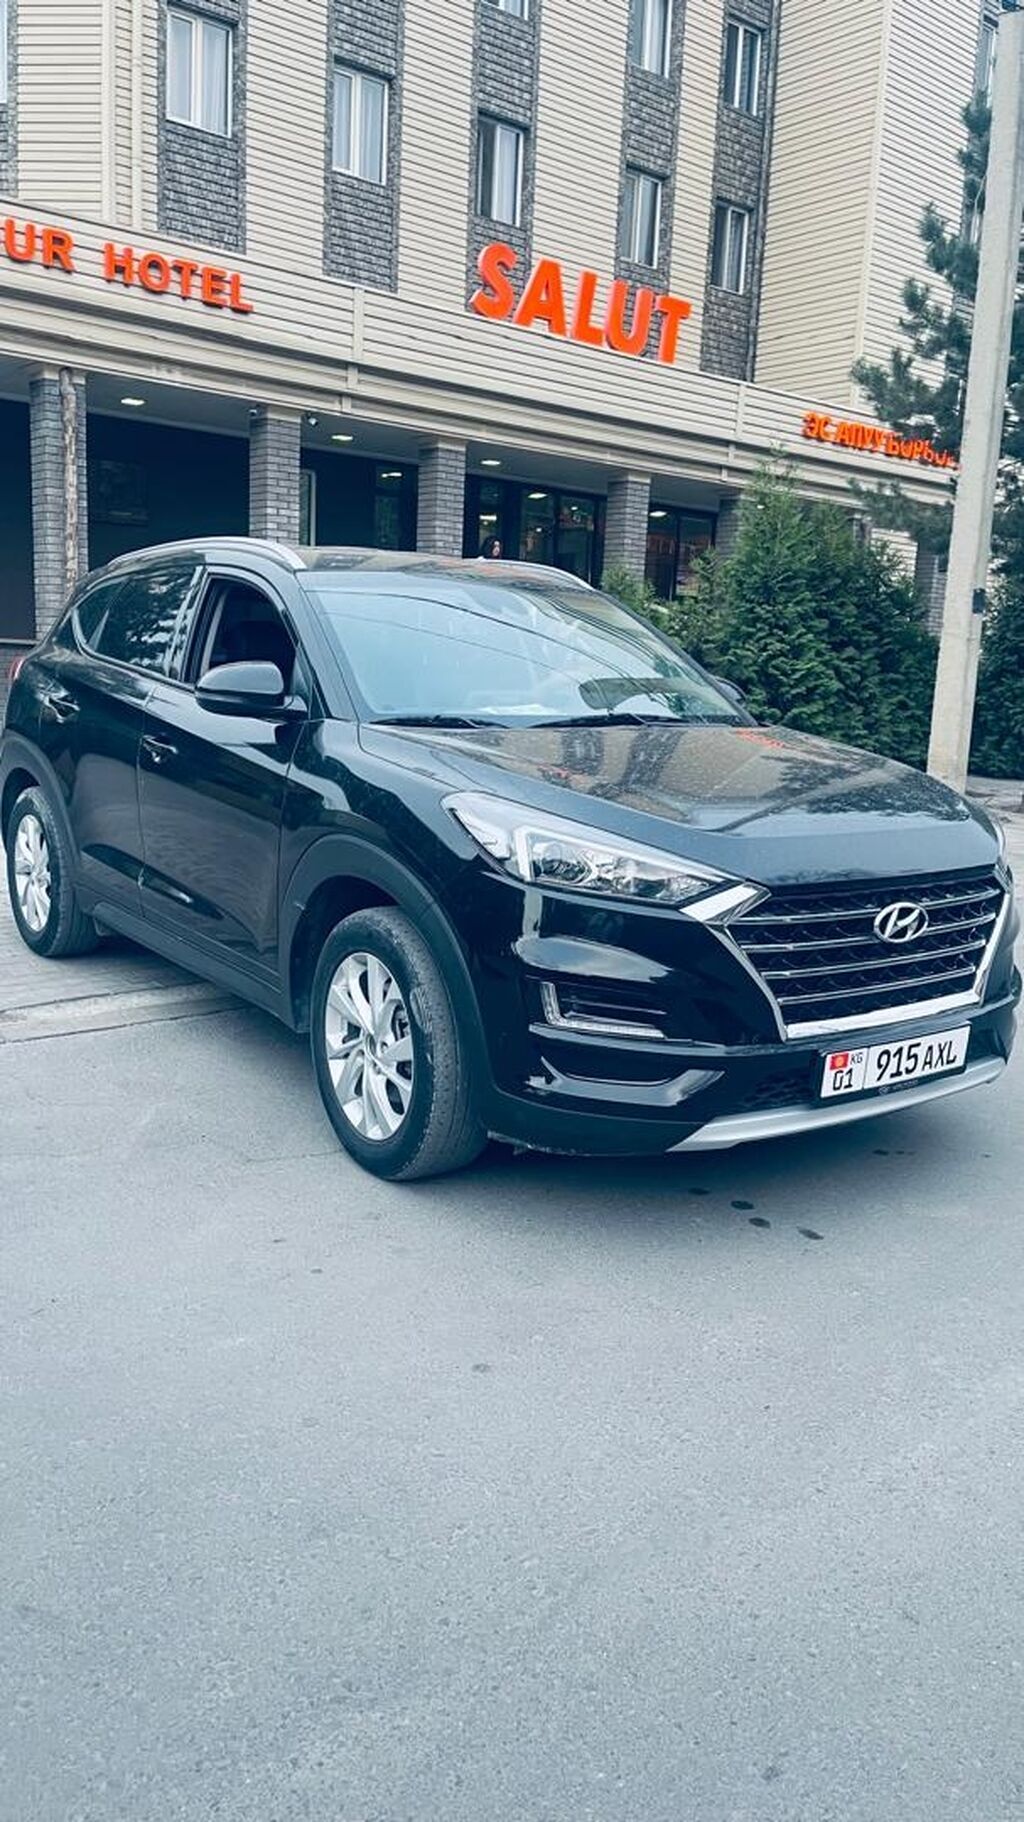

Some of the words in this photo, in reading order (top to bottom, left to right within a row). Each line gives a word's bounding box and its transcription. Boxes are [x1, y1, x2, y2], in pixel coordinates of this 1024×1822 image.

[103, 242, 254, 314] HOTEL
[470, 242, 693, 366] SALUT
[832, 1068, 854, 1092] 01
